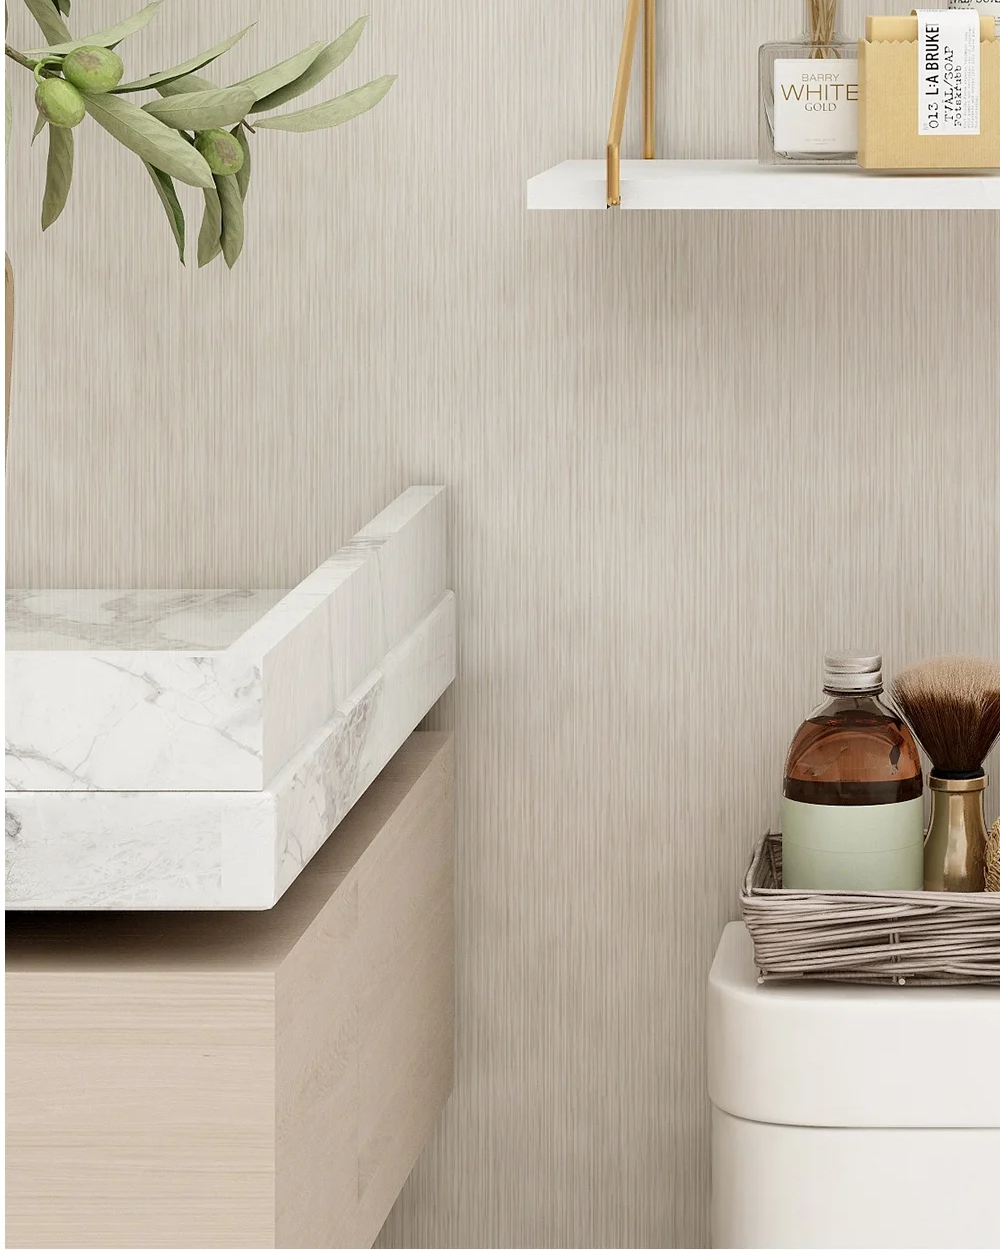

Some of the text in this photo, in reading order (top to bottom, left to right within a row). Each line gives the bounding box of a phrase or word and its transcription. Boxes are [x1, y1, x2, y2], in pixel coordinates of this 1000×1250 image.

[925, 23, 939, 70] BRUKET
[801, 73, 840, 82] BARRY
[925, 75, 939, 95] L:A
[780, 84, 859, 101] WHITE
[804, 102, 837, 111] GOLD
[928, 102, 939, 129] 013
